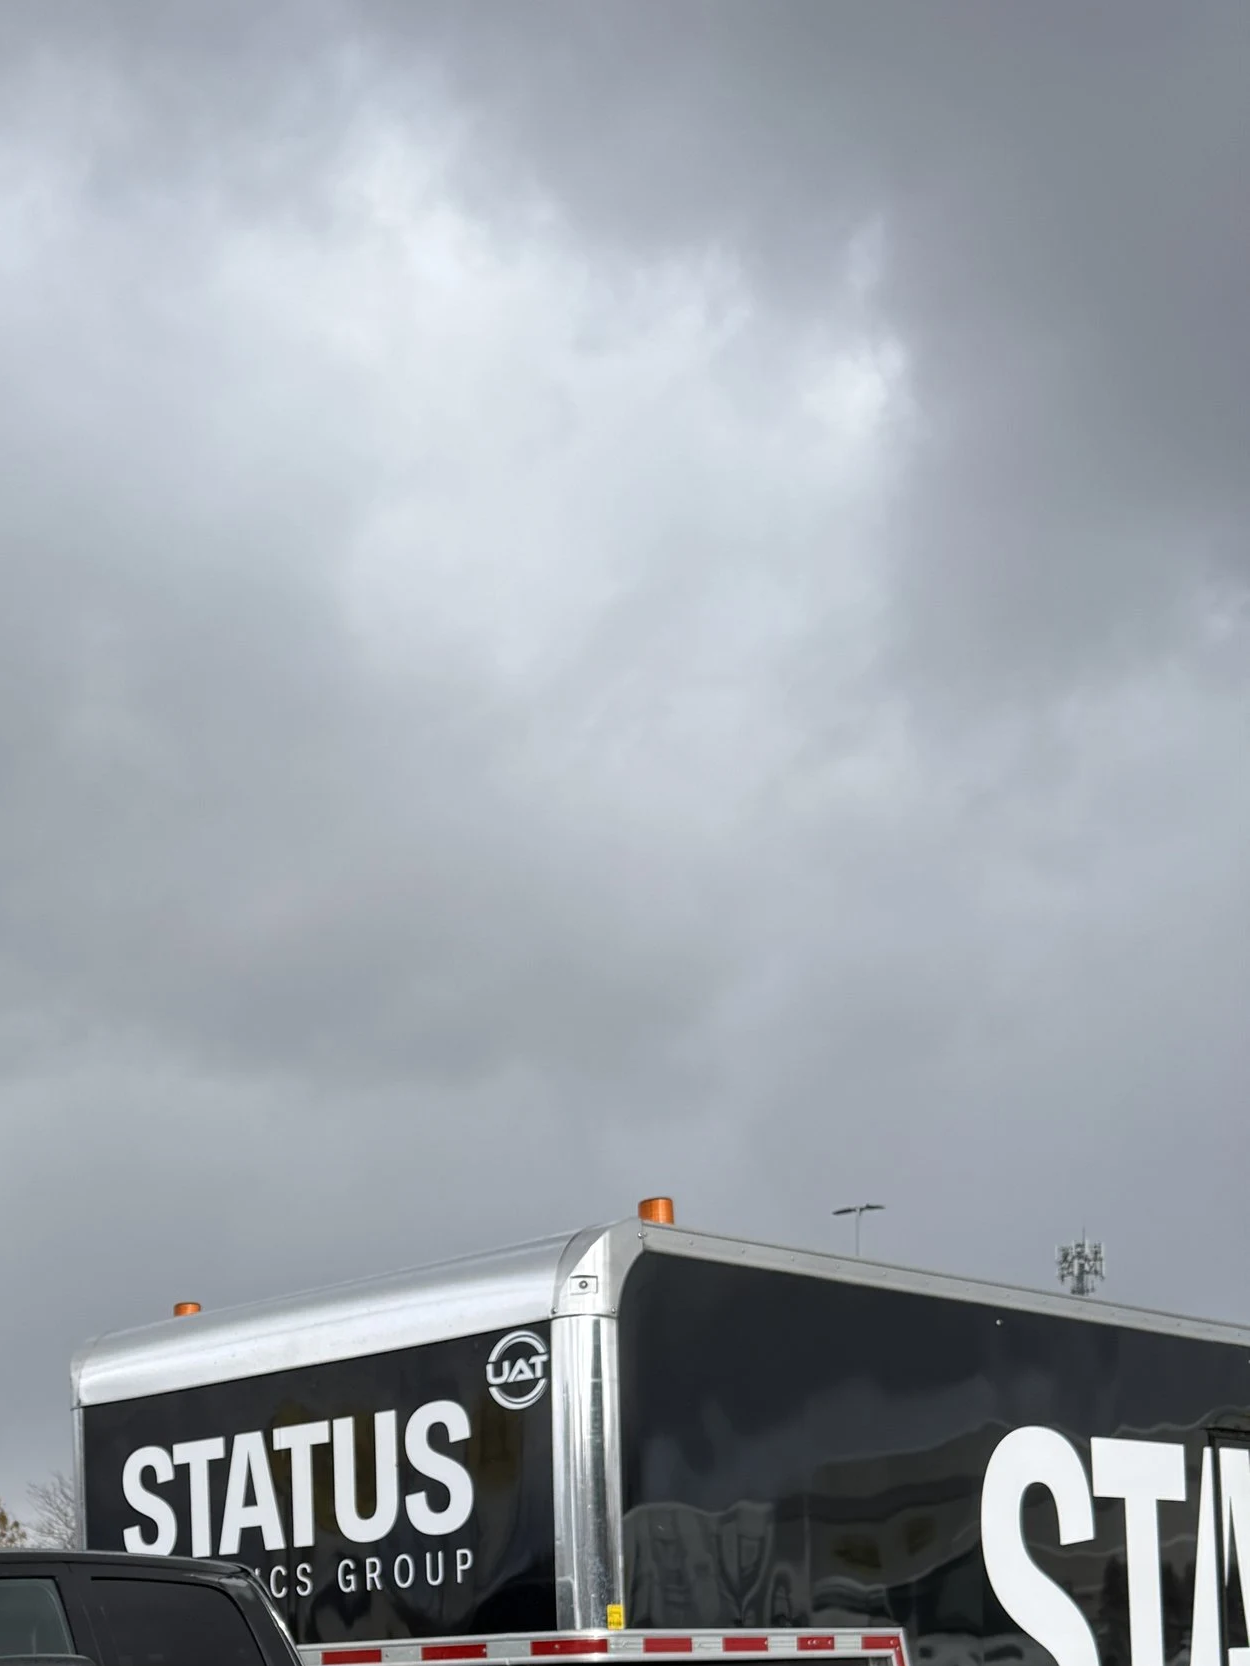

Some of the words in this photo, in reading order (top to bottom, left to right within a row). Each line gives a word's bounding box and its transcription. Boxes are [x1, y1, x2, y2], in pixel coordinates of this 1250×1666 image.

[122, 1399, 475, 1558] STATUS
[254, 1561, 314, 1599] CS
[337, 1549, 474, 1593] GROUP
